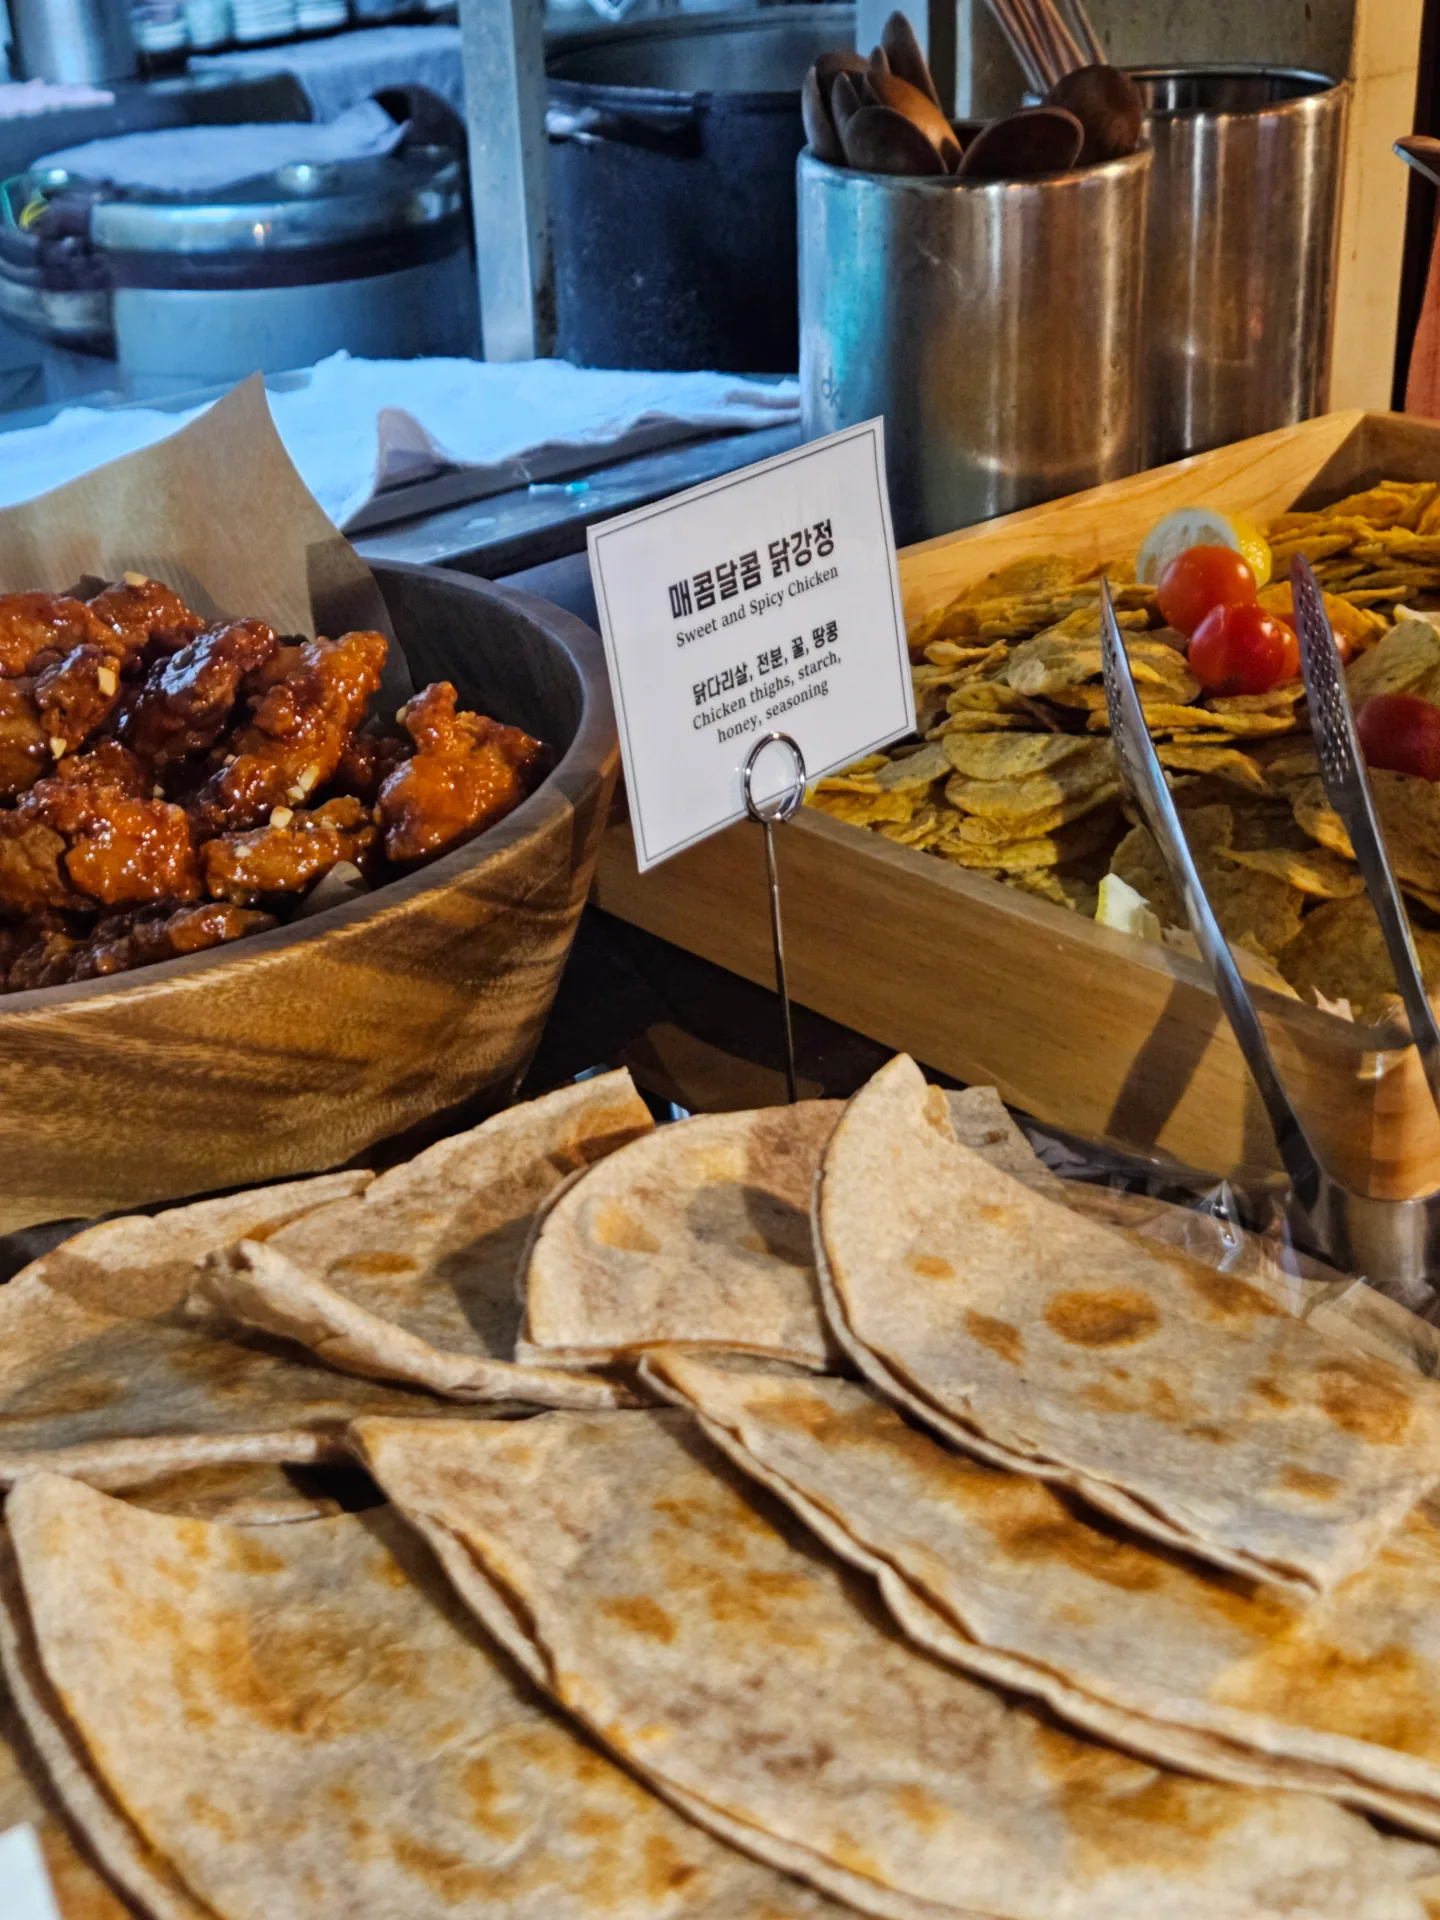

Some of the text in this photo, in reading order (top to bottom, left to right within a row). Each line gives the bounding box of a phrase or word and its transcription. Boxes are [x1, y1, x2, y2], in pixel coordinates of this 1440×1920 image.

[668, 519, 834, 618] 매콤달콤 닭강정
[676, 566, 839, 648] Sweet and Spicy Chicken
[692, 620, 839, 706] 닭다리살, 전분, 꿀, 땅콩
[693, 651, 842, 730] Chicken thighs, starch,
[717, 680, 829, 743] honey, seasoning
